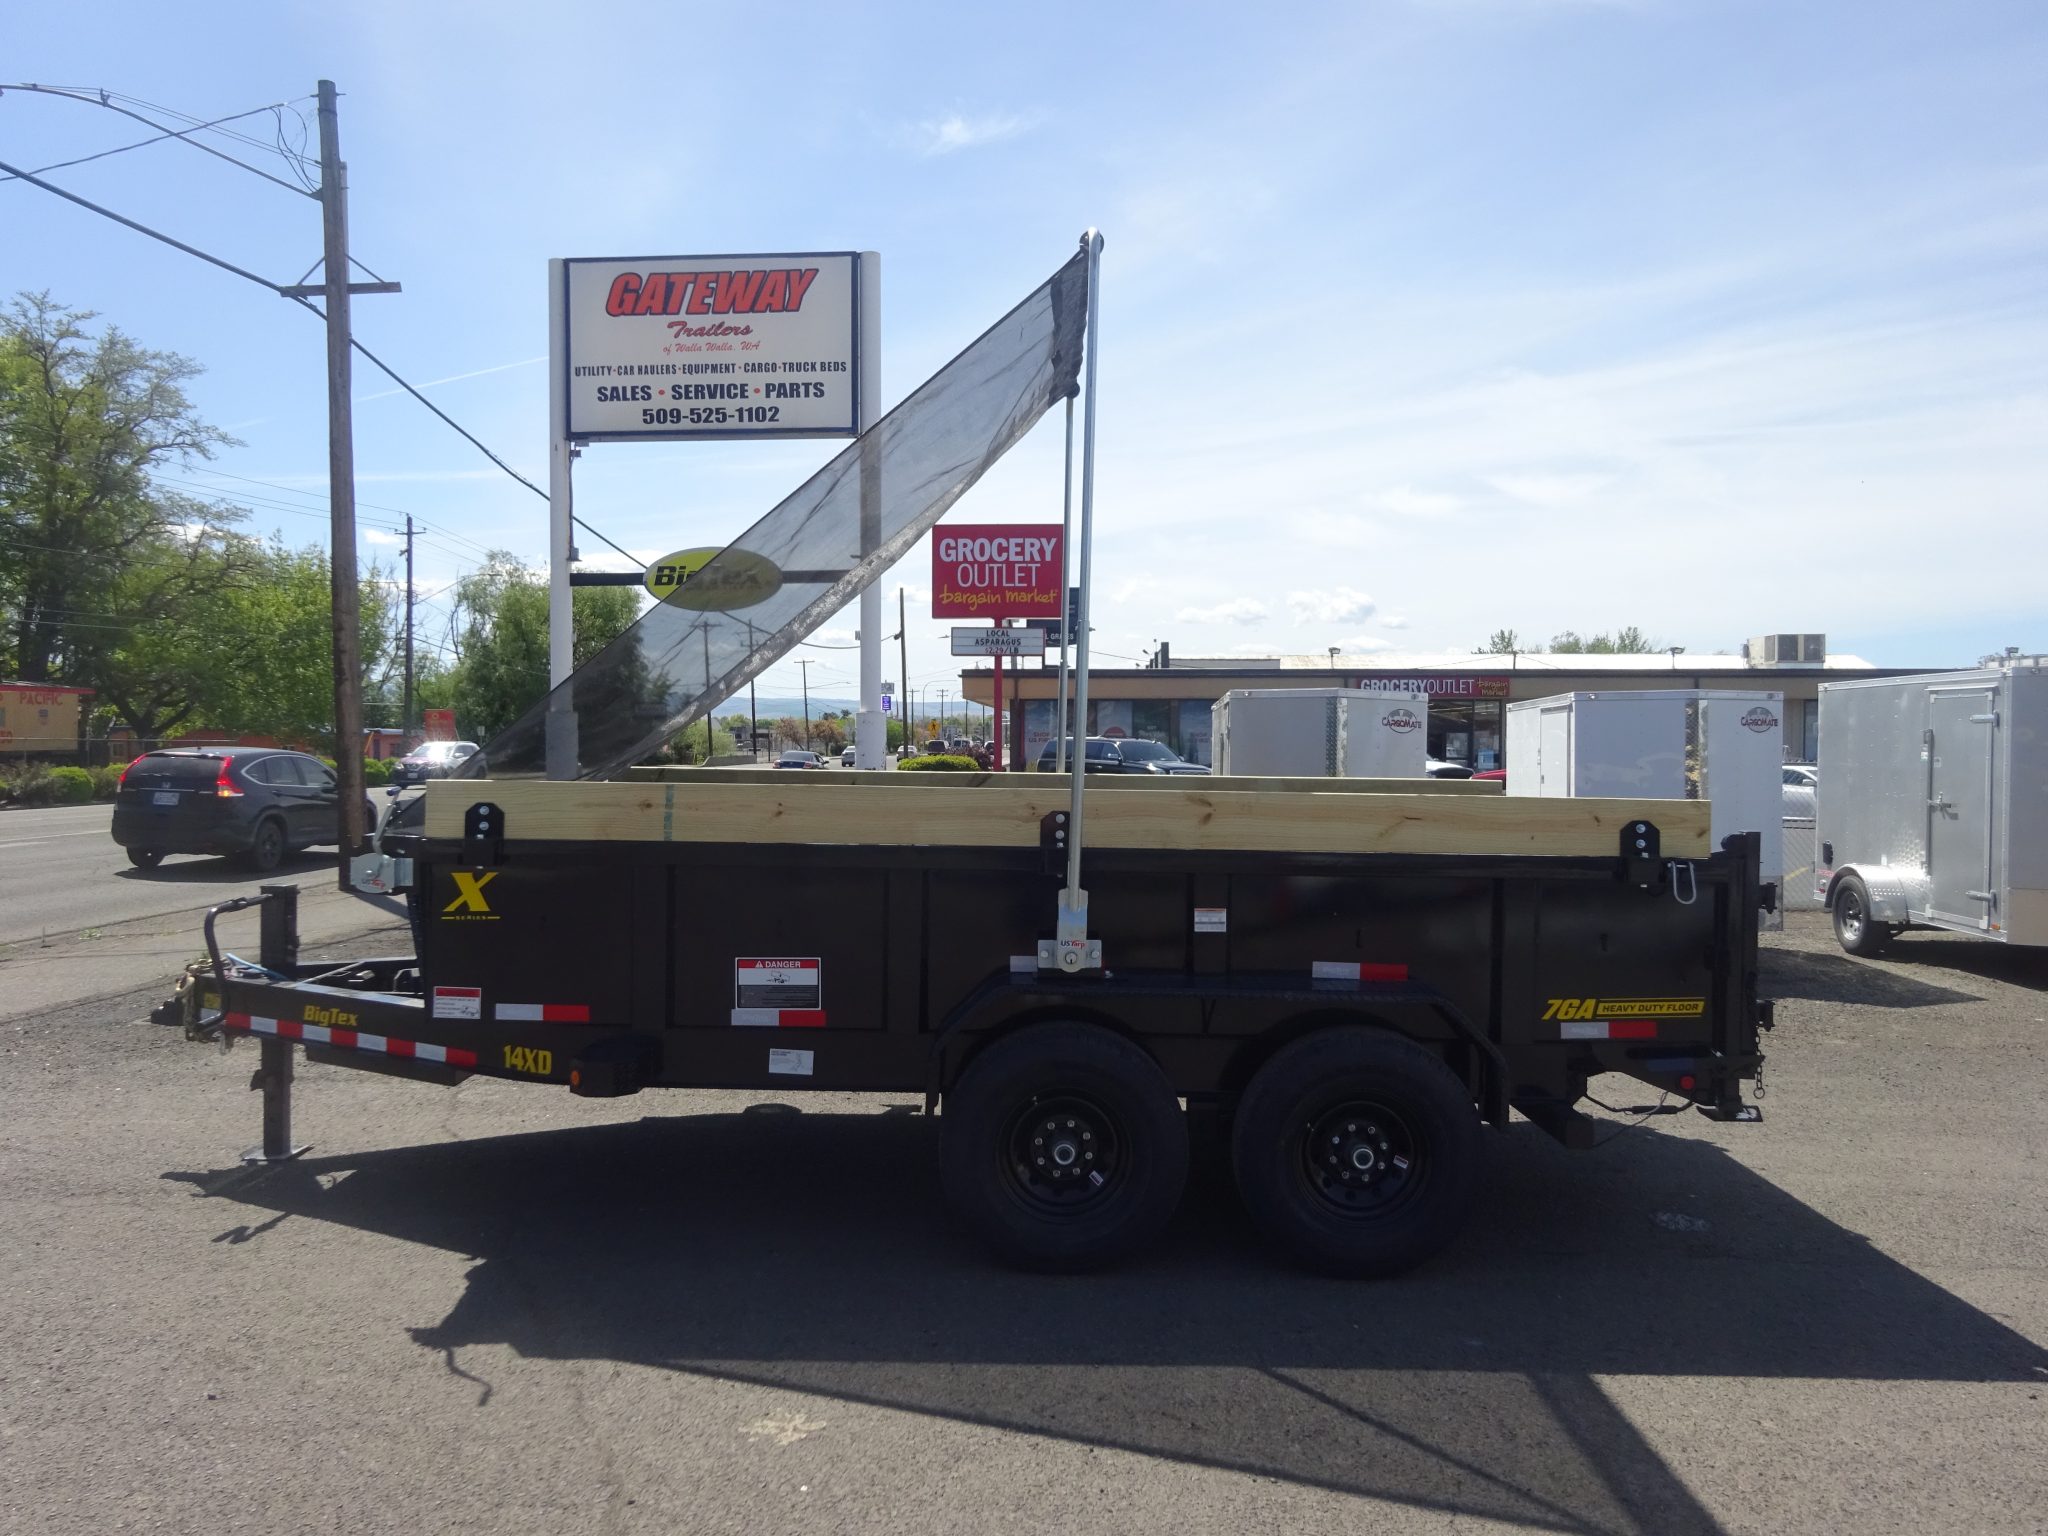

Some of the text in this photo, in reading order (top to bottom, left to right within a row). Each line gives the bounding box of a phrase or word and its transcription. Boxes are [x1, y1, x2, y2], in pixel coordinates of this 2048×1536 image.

[605, 268, 819, 317] GATEWAY
[667, 321, 753, 339] Trailers
[662, 343, 672, 356] of
[675, 342, 703, 353] Walla
[740, 340, 761, 351] WA
[575, 361, 847, 377] UTILITY CAR HAULERS EQUIPMENT CARGO TRUCK BEDS
[597, 381, 825, 403] SALES SERVICE PARTS
[642, 406, 780, 425] 509-525-1102
[939, 537, 1057, 562] GROCERY
[957, 563, 1041, 588] OUTLET
[939, 583, 1057, 611] bargain market
[974, 638, 1022, 646] ASPARAGUS
[986, 629, 1010, 637] LOCAL
[1360, 679, 1474, 694] GROCERY OUTLET
[19, 692, 63, 706] PACIFIC
[442, 871, 499, 912] X
[765, 960, 801, 968] DANGER
[303, 1003, 359, 1027] BigTex
[1540, 998, 1699, 1021] 7GA HEAVY DUTY FLOOR
[503, 1044, 553, 1076] 14XD
